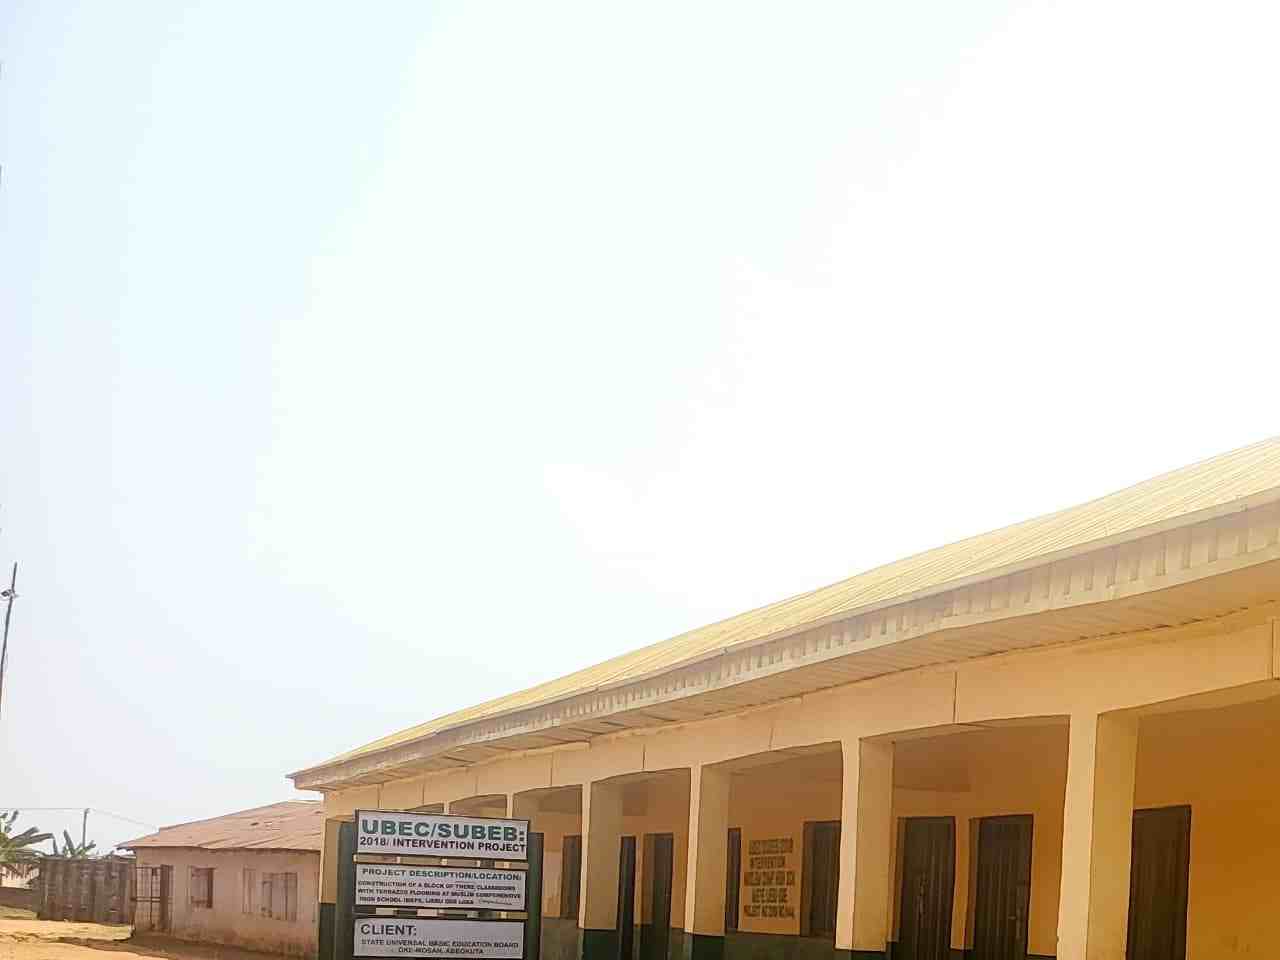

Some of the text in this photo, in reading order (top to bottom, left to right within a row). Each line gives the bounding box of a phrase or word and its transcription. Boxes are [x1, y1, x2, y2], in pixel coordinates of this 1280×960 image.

[362, 819, 525, 842] UBEC/SUBEB:
[393, 838, 474, 850] INTERVENTION
[478, 842, 526, 852] PROJECT
[362, 868, 405, 876] PROJECT
[360, 923, 417, 936] CLIENT:
